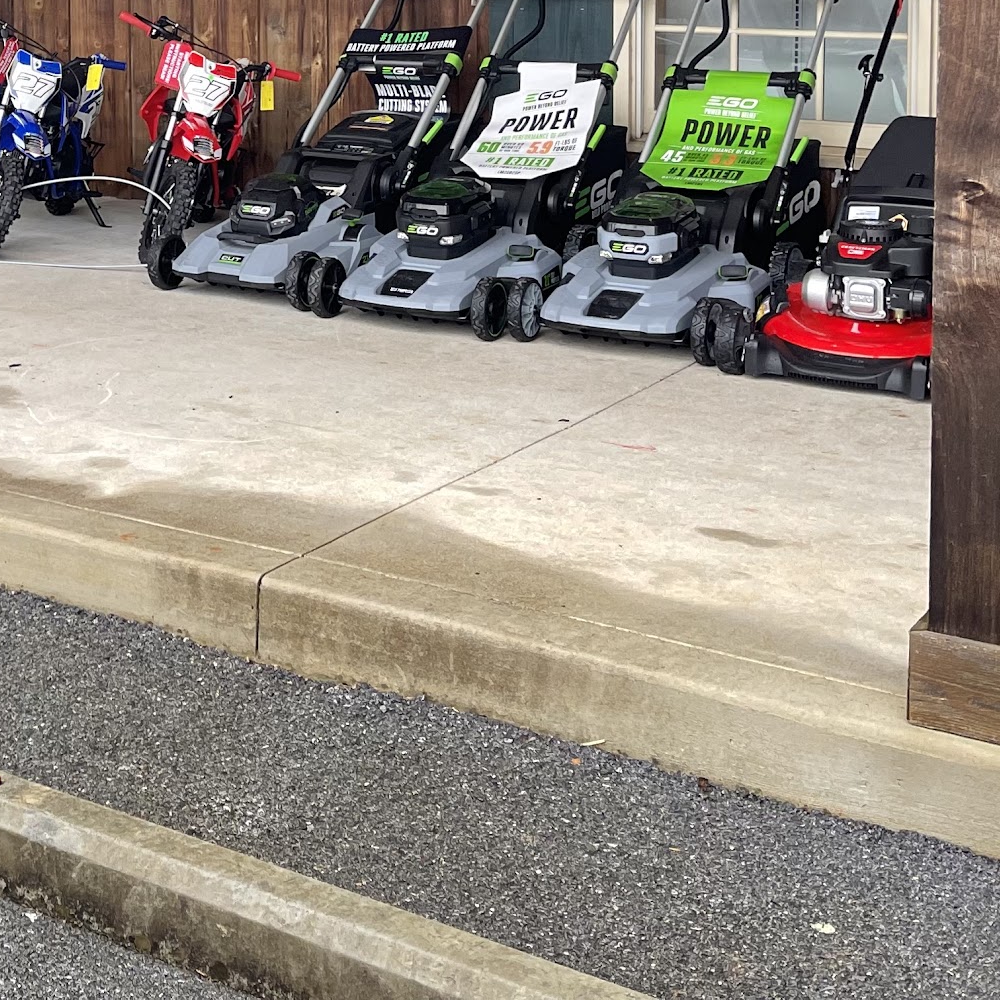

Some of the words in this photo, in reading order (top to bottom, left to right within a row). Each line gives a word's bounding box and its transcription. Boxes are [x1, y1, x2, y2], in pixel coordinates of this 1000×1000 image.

[380, 32, 392, 44] #1
[395, 31, 429, 43] RATED
[346, 43, 379, 52] BATTERY
[379, 43, 416, 52] POWERED
[416, 40, 457, 51] PLATFORM
[382, 66, 417, 75] EGO
[13, 72, 55, 98] 27
[184, 74, 230, 102] 27
[524, 89, 568, 104] EGO
[706, 96, 758, 109] EGO
[378, 99, 413, 111] CUTTING
[498, 107, 578, 134] POWER
[680, 119, 771, 149] POWER
[476, 142, 501, 153] 60
[526, 141, 553, 154] 5.9
[510, 158, 548, 167] RATED
[660, 150, 686, 163] 45
[668, 167, 686, 176] #1
[693, 168, 739, 180] RATED
[242, 204, 270, 214] EGO
[407, 224, 439, 236] EGO
[612, 242, 647, 254] EGO
